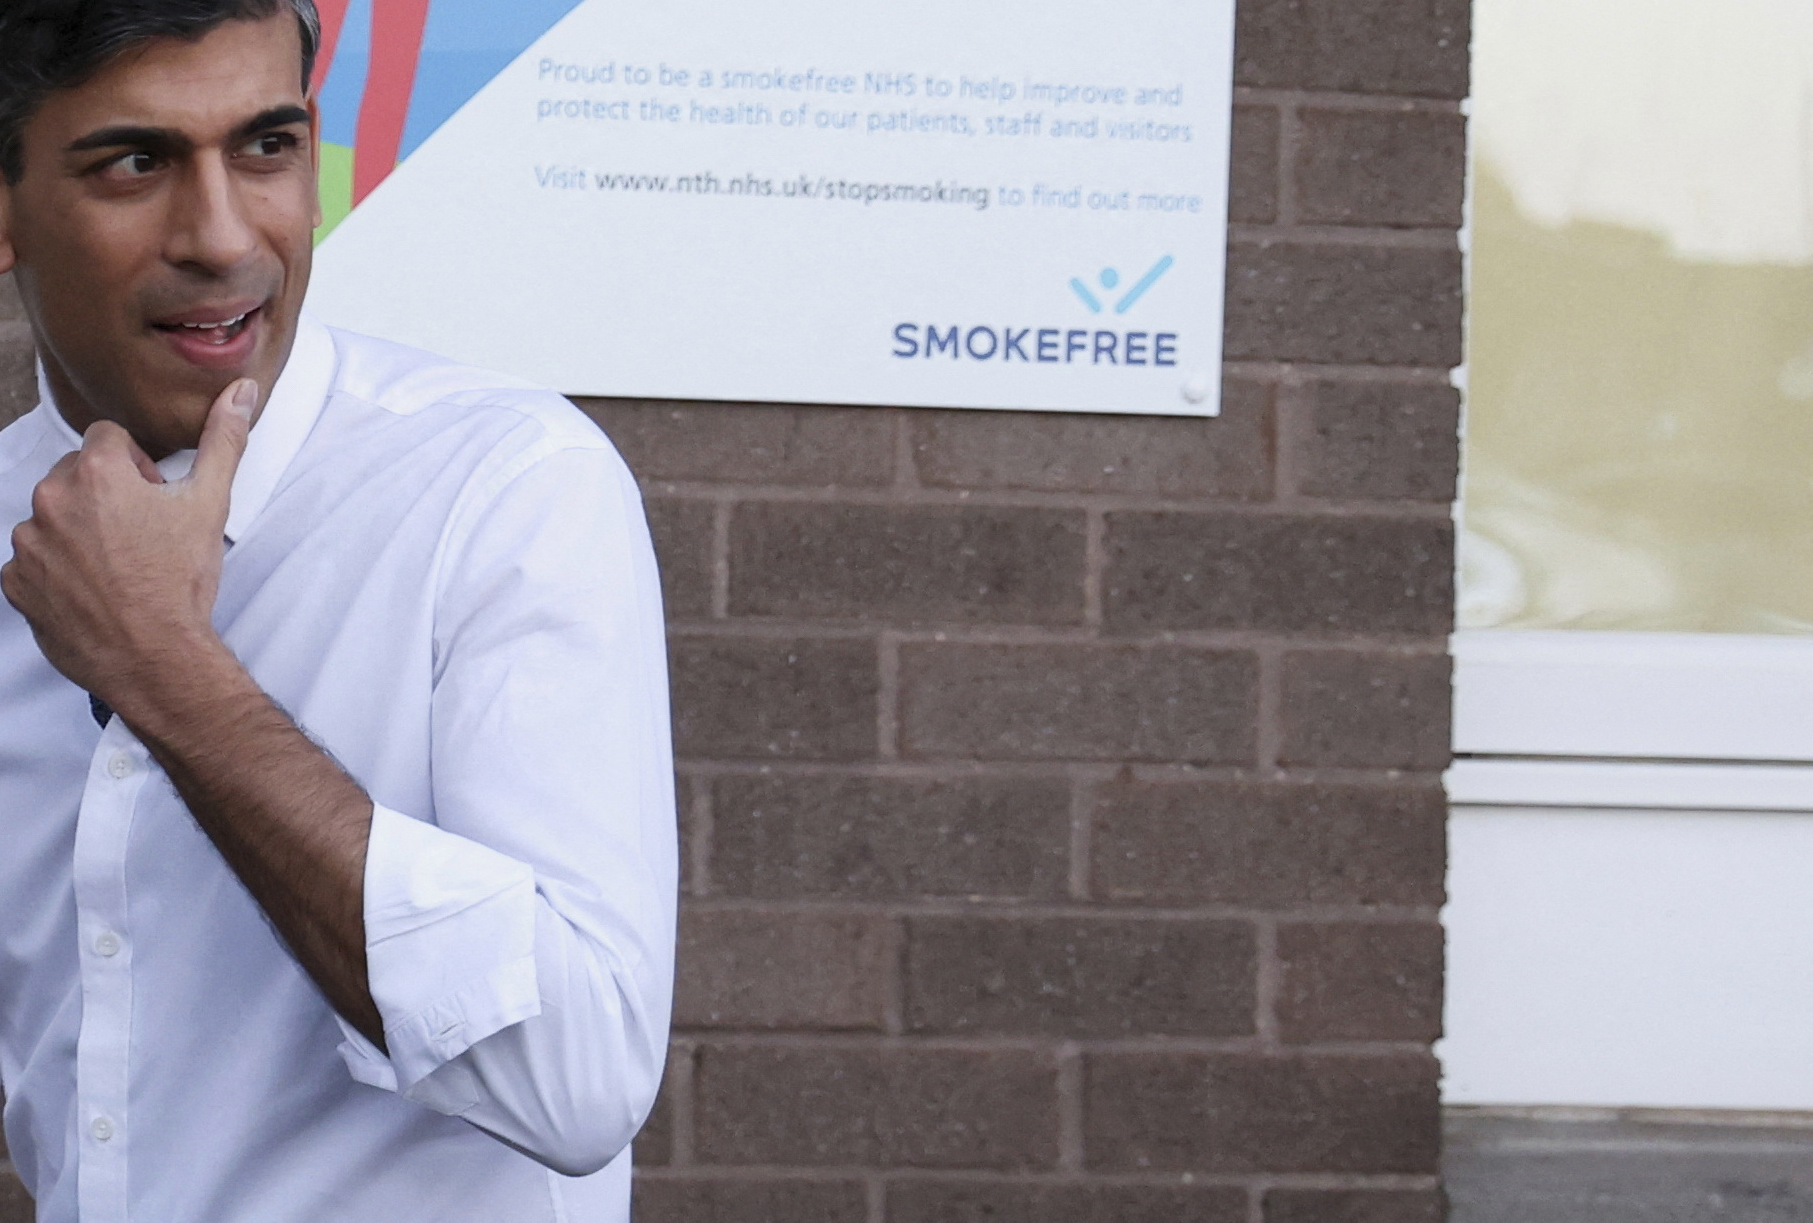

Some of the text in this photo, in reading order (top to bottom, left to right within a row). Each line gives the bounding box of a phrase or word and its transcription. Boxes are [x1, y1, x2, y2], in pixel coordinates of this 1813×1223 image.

[539, 58, 1183, 107] Proud to be a smokefree NHS to help improve and
[537, 97, 1193, 142] protect the health of our patients, staff and visitors
[534, 165, 1202, 213] Visit www.nth.nhs.uk/stopsmoking to find out more
[891, 322, 1179, 368] SMOKEFREE
